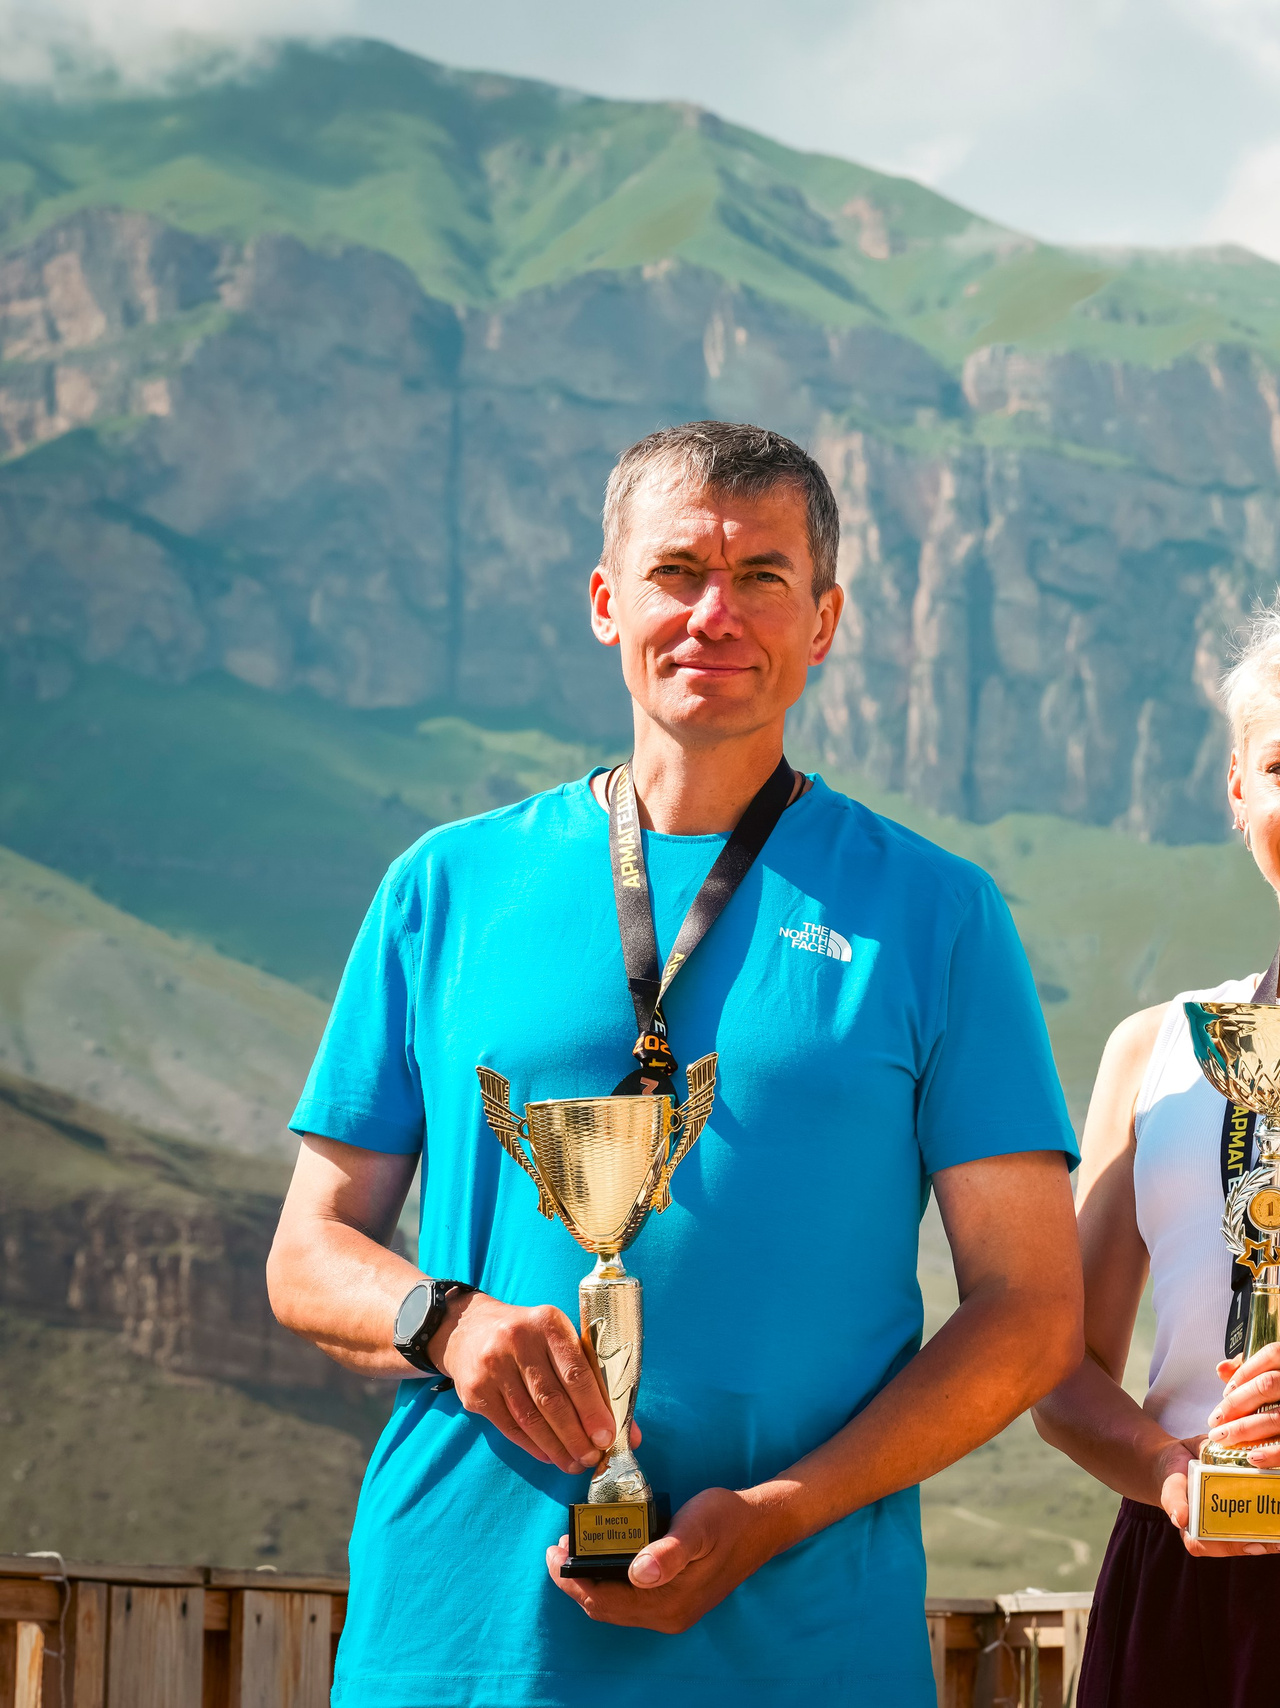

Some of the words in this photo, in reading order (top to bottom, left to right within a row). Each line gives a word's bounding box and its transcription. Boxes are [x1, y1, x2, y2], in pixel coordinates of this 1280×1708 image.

[779, 926, 829, 946] NORTH
[802, 921, 830, 937] THE
[791, 938, 827, 956] FACE
[1266, 1201, 1274, 1217] 1
[1236, 1291, 1243, 1320] 1
[1211, 1493, 1252, 1518] Super
[595, 1515, 603, 1526] III
[605, 1516, 629, 1525] место
[582, 1530, 604, 1543] Super
[607, 1529, 626, 1540] Ultra
[628, 1528, 642, 1539] 500
